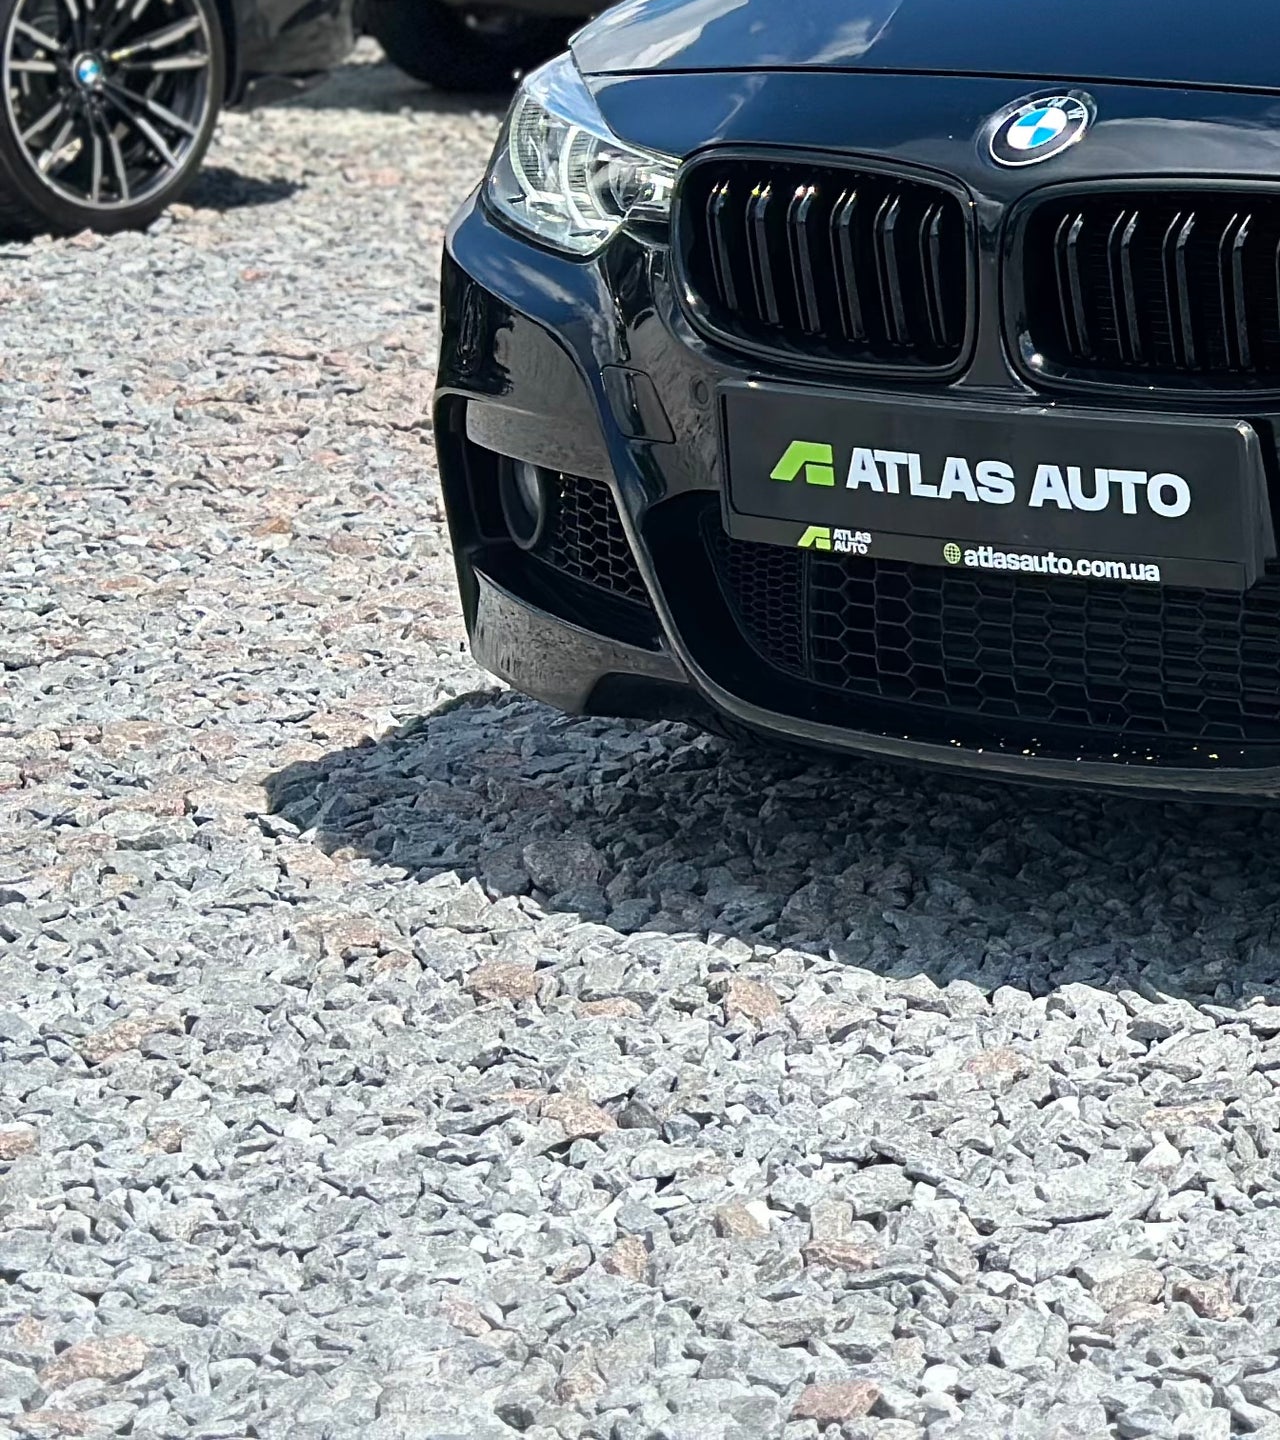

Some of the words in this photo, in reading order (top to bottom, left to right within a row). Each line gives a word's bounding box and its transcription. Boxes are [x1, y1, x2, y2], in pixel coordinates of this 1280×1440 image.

[846, 447, 1015, 505] ATLAS
[1029, 464, 1192, 518] AUTO
[833, 528, 872, 544] ATLAS
[834, 541, 868, 555] AUTO
[964, 546, 1160, 582] atlasauto.com.ua
